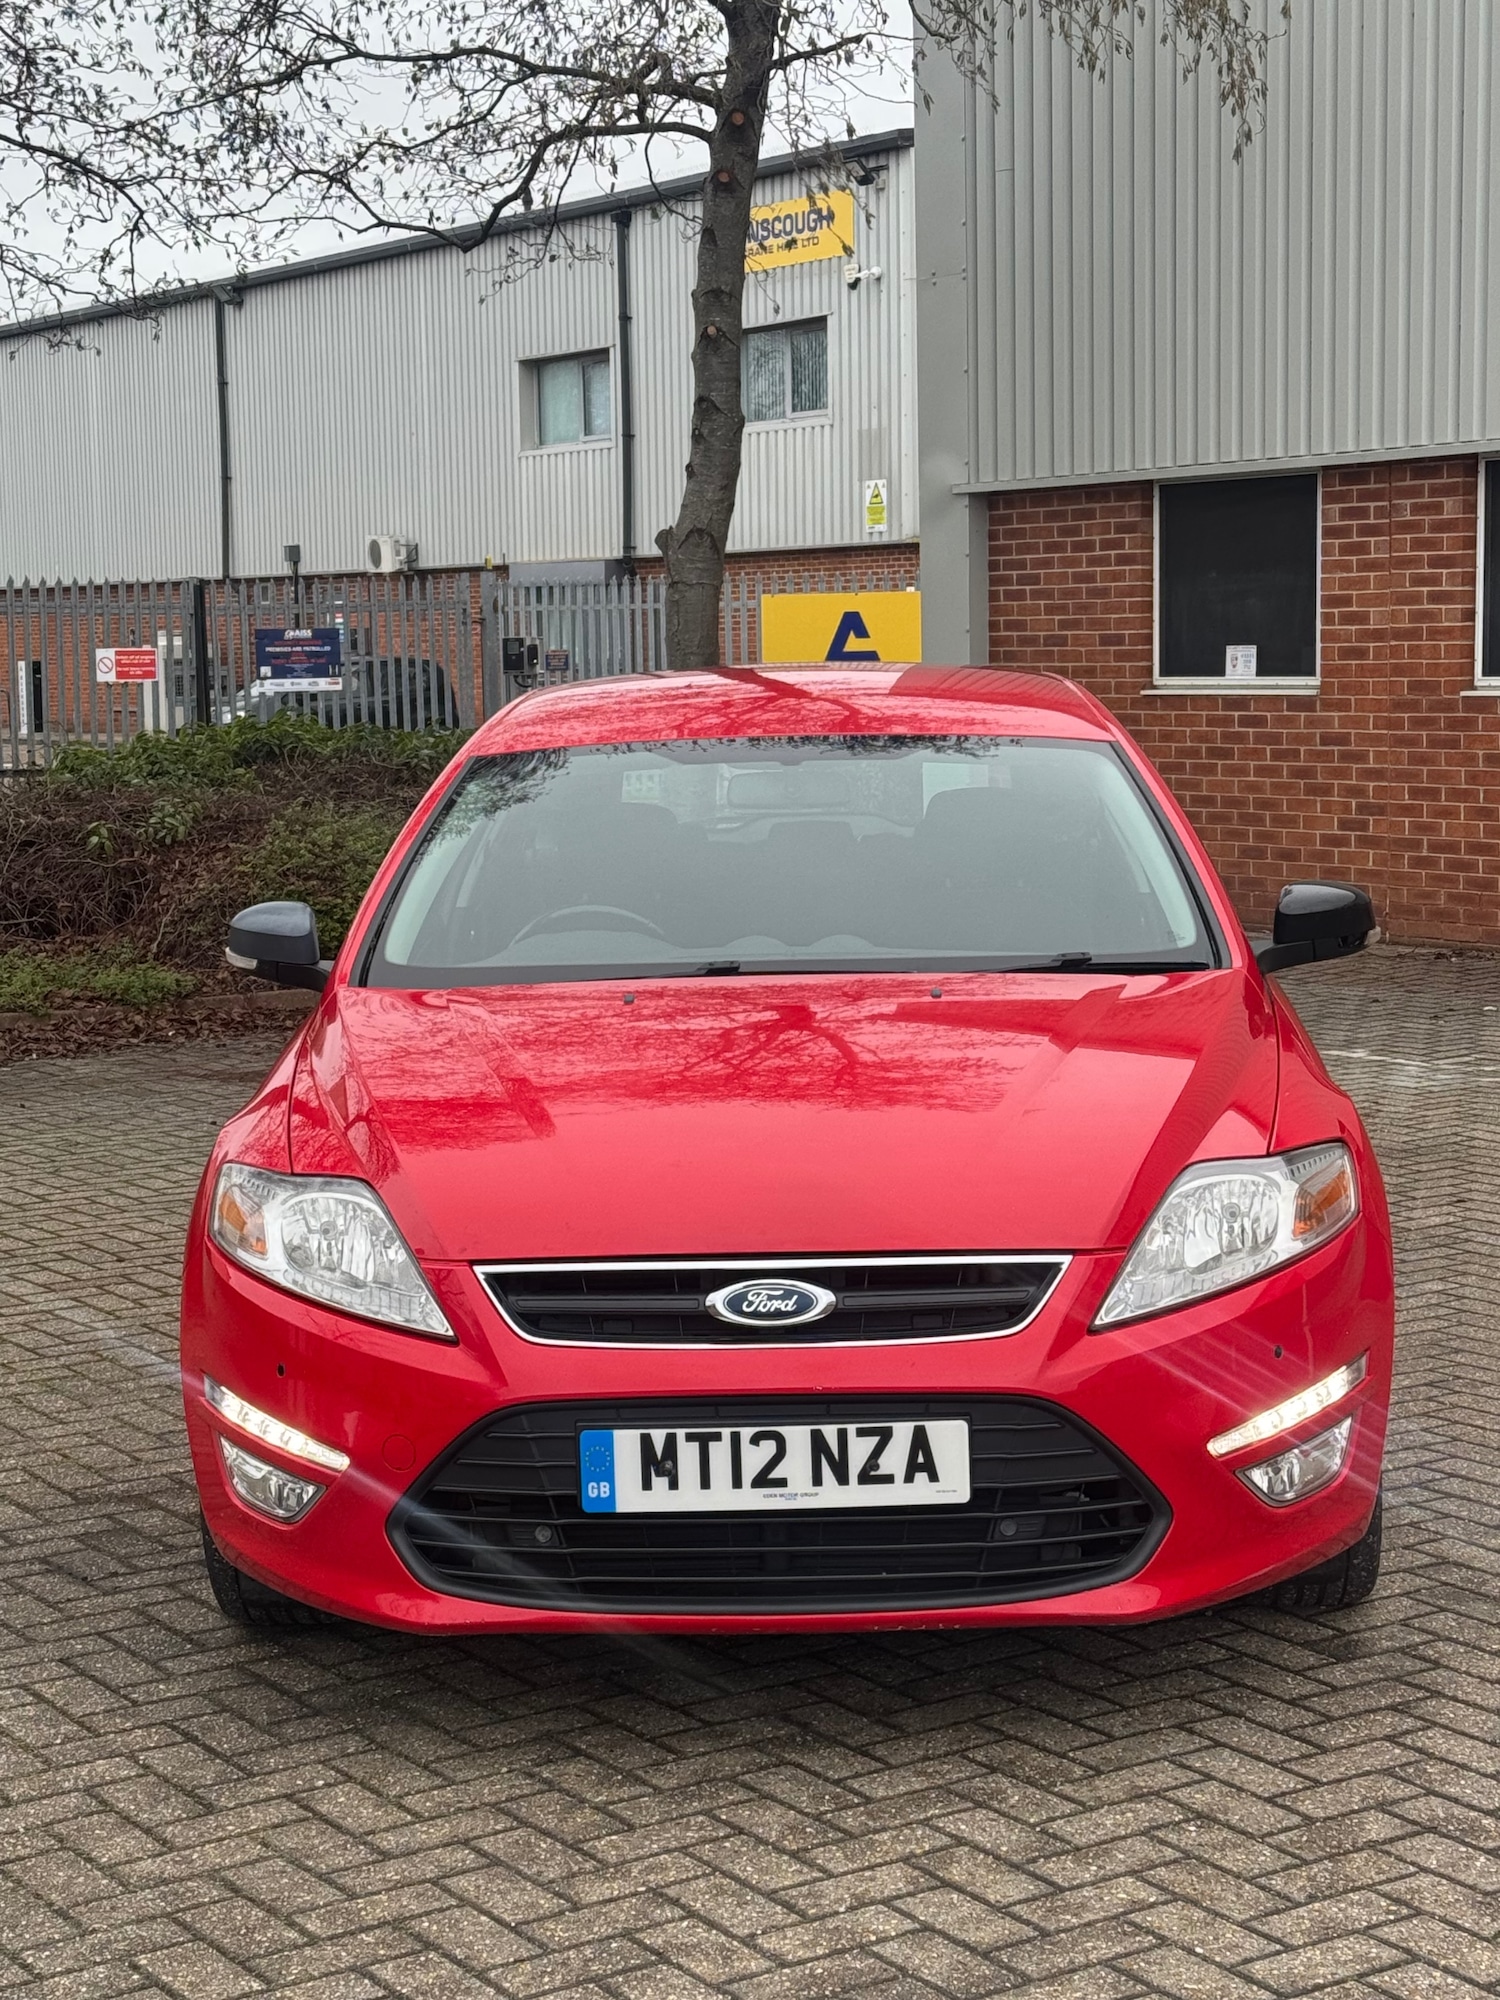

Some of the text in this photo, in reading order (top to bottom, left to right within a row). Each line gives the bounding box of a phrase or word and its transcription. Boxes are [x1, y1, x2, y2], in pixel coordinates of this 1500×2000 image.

[745, 244, 775, 257] RANE
[801, 236, 819, 248] LTD
[742, 1289, 798, 1312] Ford
[639, 1425, 940, 1491] MT12 NZA
[587, 1482, 610, 1498] GB
